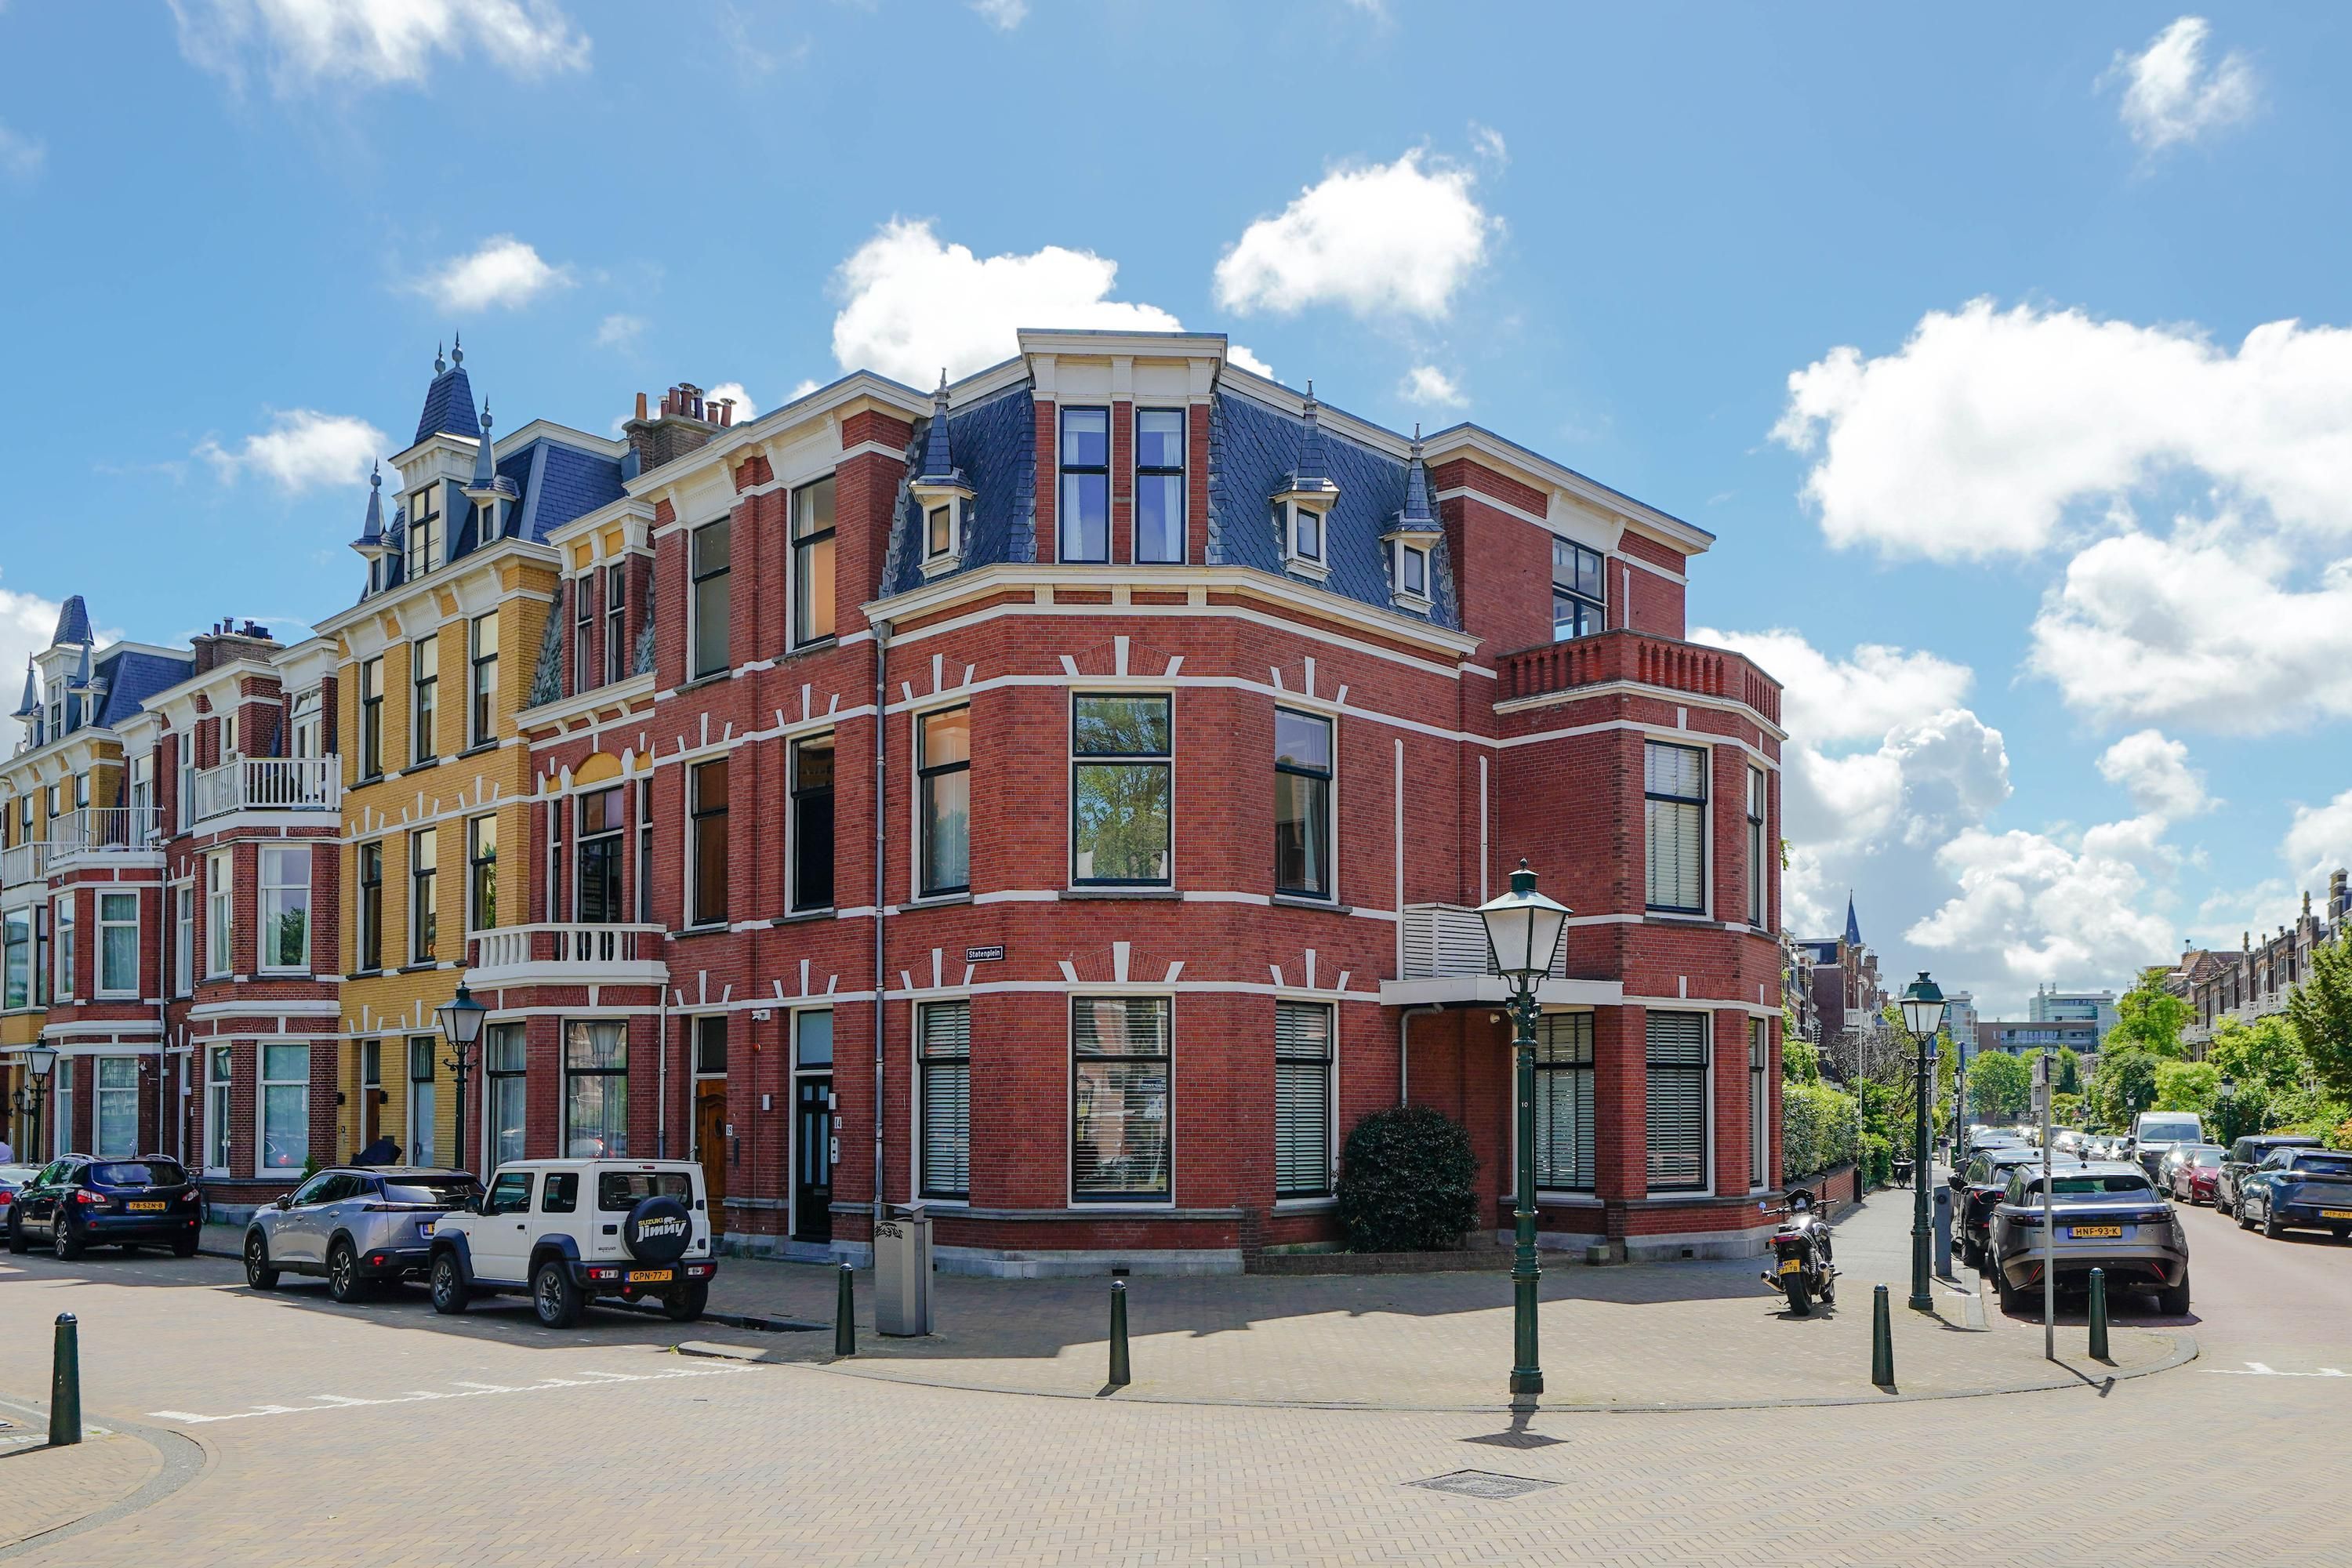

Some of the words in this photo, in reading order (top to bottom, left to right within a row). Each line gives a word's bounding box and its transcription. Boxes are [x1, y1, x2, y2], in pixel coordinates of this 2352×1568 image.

[968, 949, 1000, 958] Statenplein
[835, 1118, 841, 1127] 14
[727, 1126, 732, 1134] 15
[637, 1218, 664, 1226] SUZUKI
[636, 1223, 687, 1243] Jimny
[633, 1270, 669, 1281] GPN-77-J
